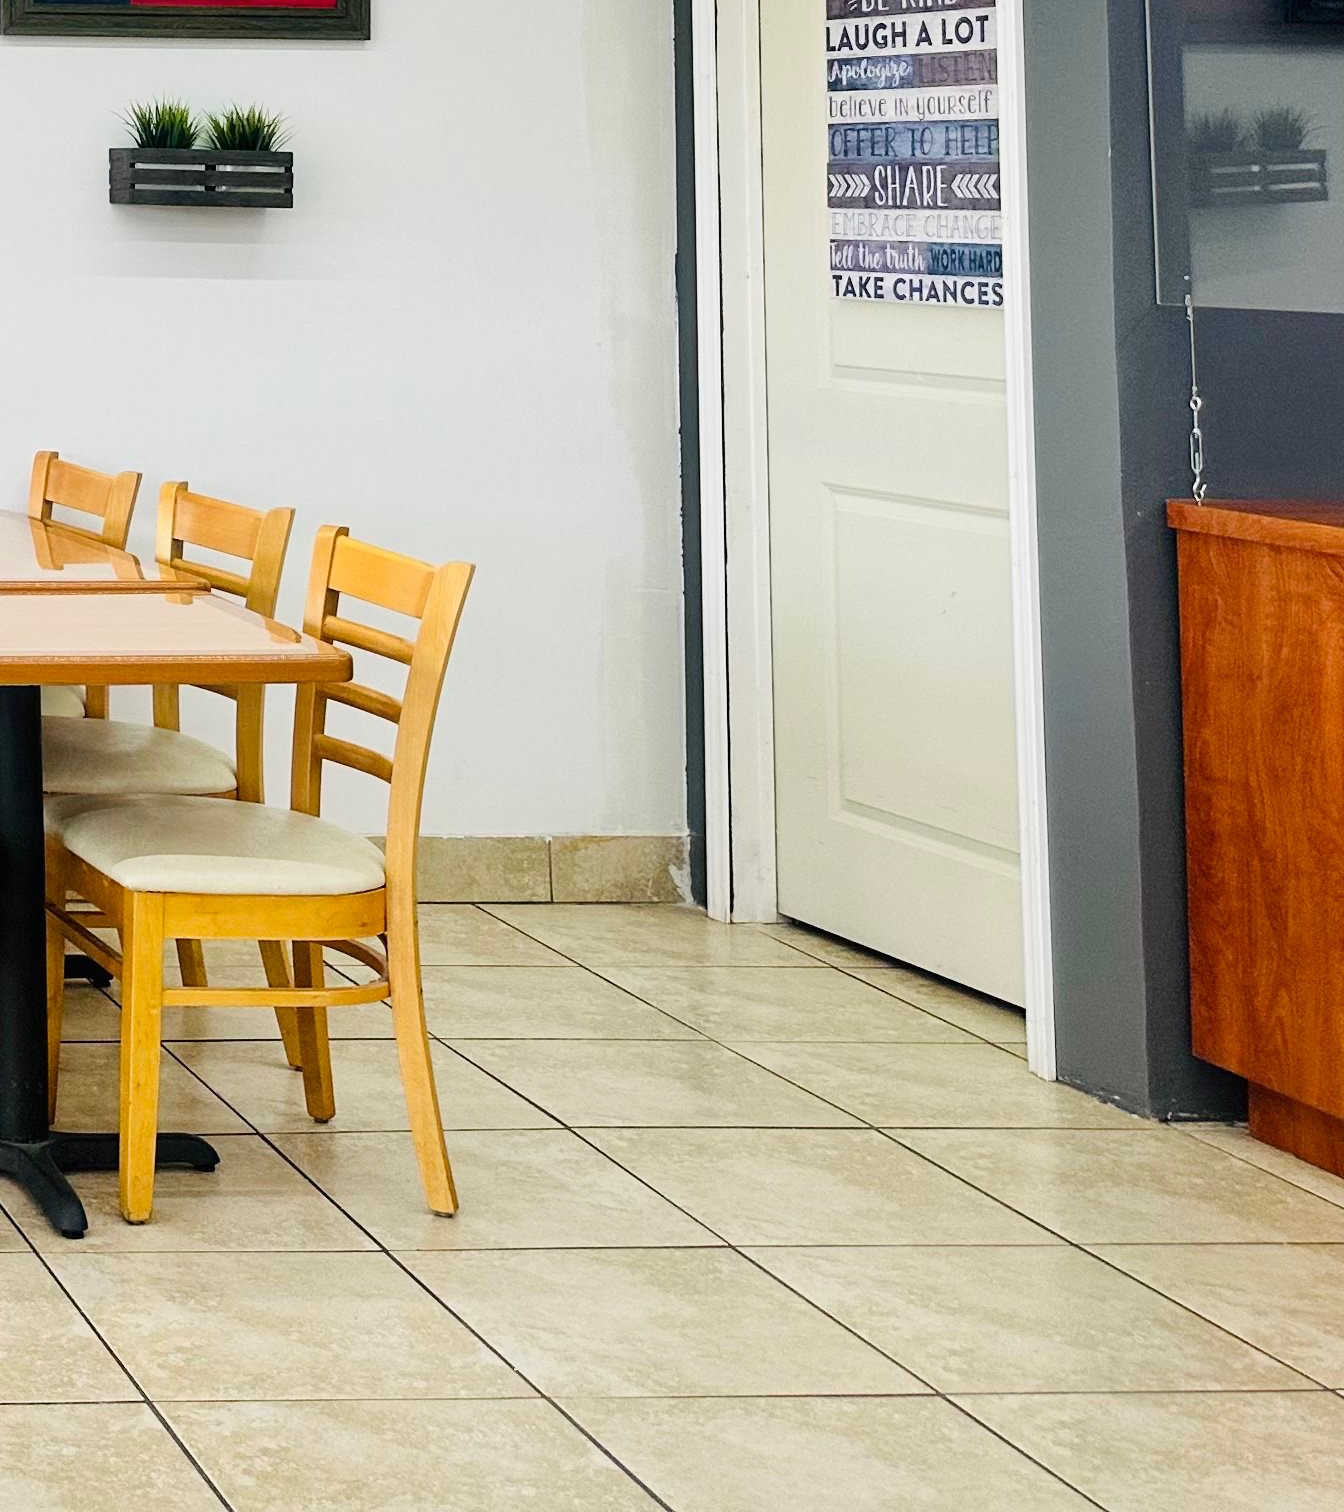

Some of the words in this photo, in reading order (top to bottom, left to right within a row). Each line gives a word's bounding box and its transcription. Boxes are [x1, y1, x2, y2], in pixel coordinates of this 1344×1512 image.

[825, 21, 907, 52] LAUGH
[915, 20, 932, 46] A
[941, 15, 989, 44] LOT
[828, 58, 912, 88] Apologize
[918, 52, 994, 84] LISTEN
[829, 96, 887, 118] believe
[831, 126, 898, 157] OFFER
[907, 127, 934, 157] TO
[944, 124, 999, 156] HELP
[874, 165, 949, 207] SHARE
[831, 212, 917, 238] EMBRACE
[923, 214, 1002, 241] CHANGE
[830, 241, 853, 268] Tell
[858, 243, 882, 269] the
[885, 243, 926, 271] truth
[930, 248, 965, 273] WORK
[969, 249, 1002, 273] HARD
[832, 274, 884, 299] TAKE
[893, 277, 1004, 307] CHANCES
